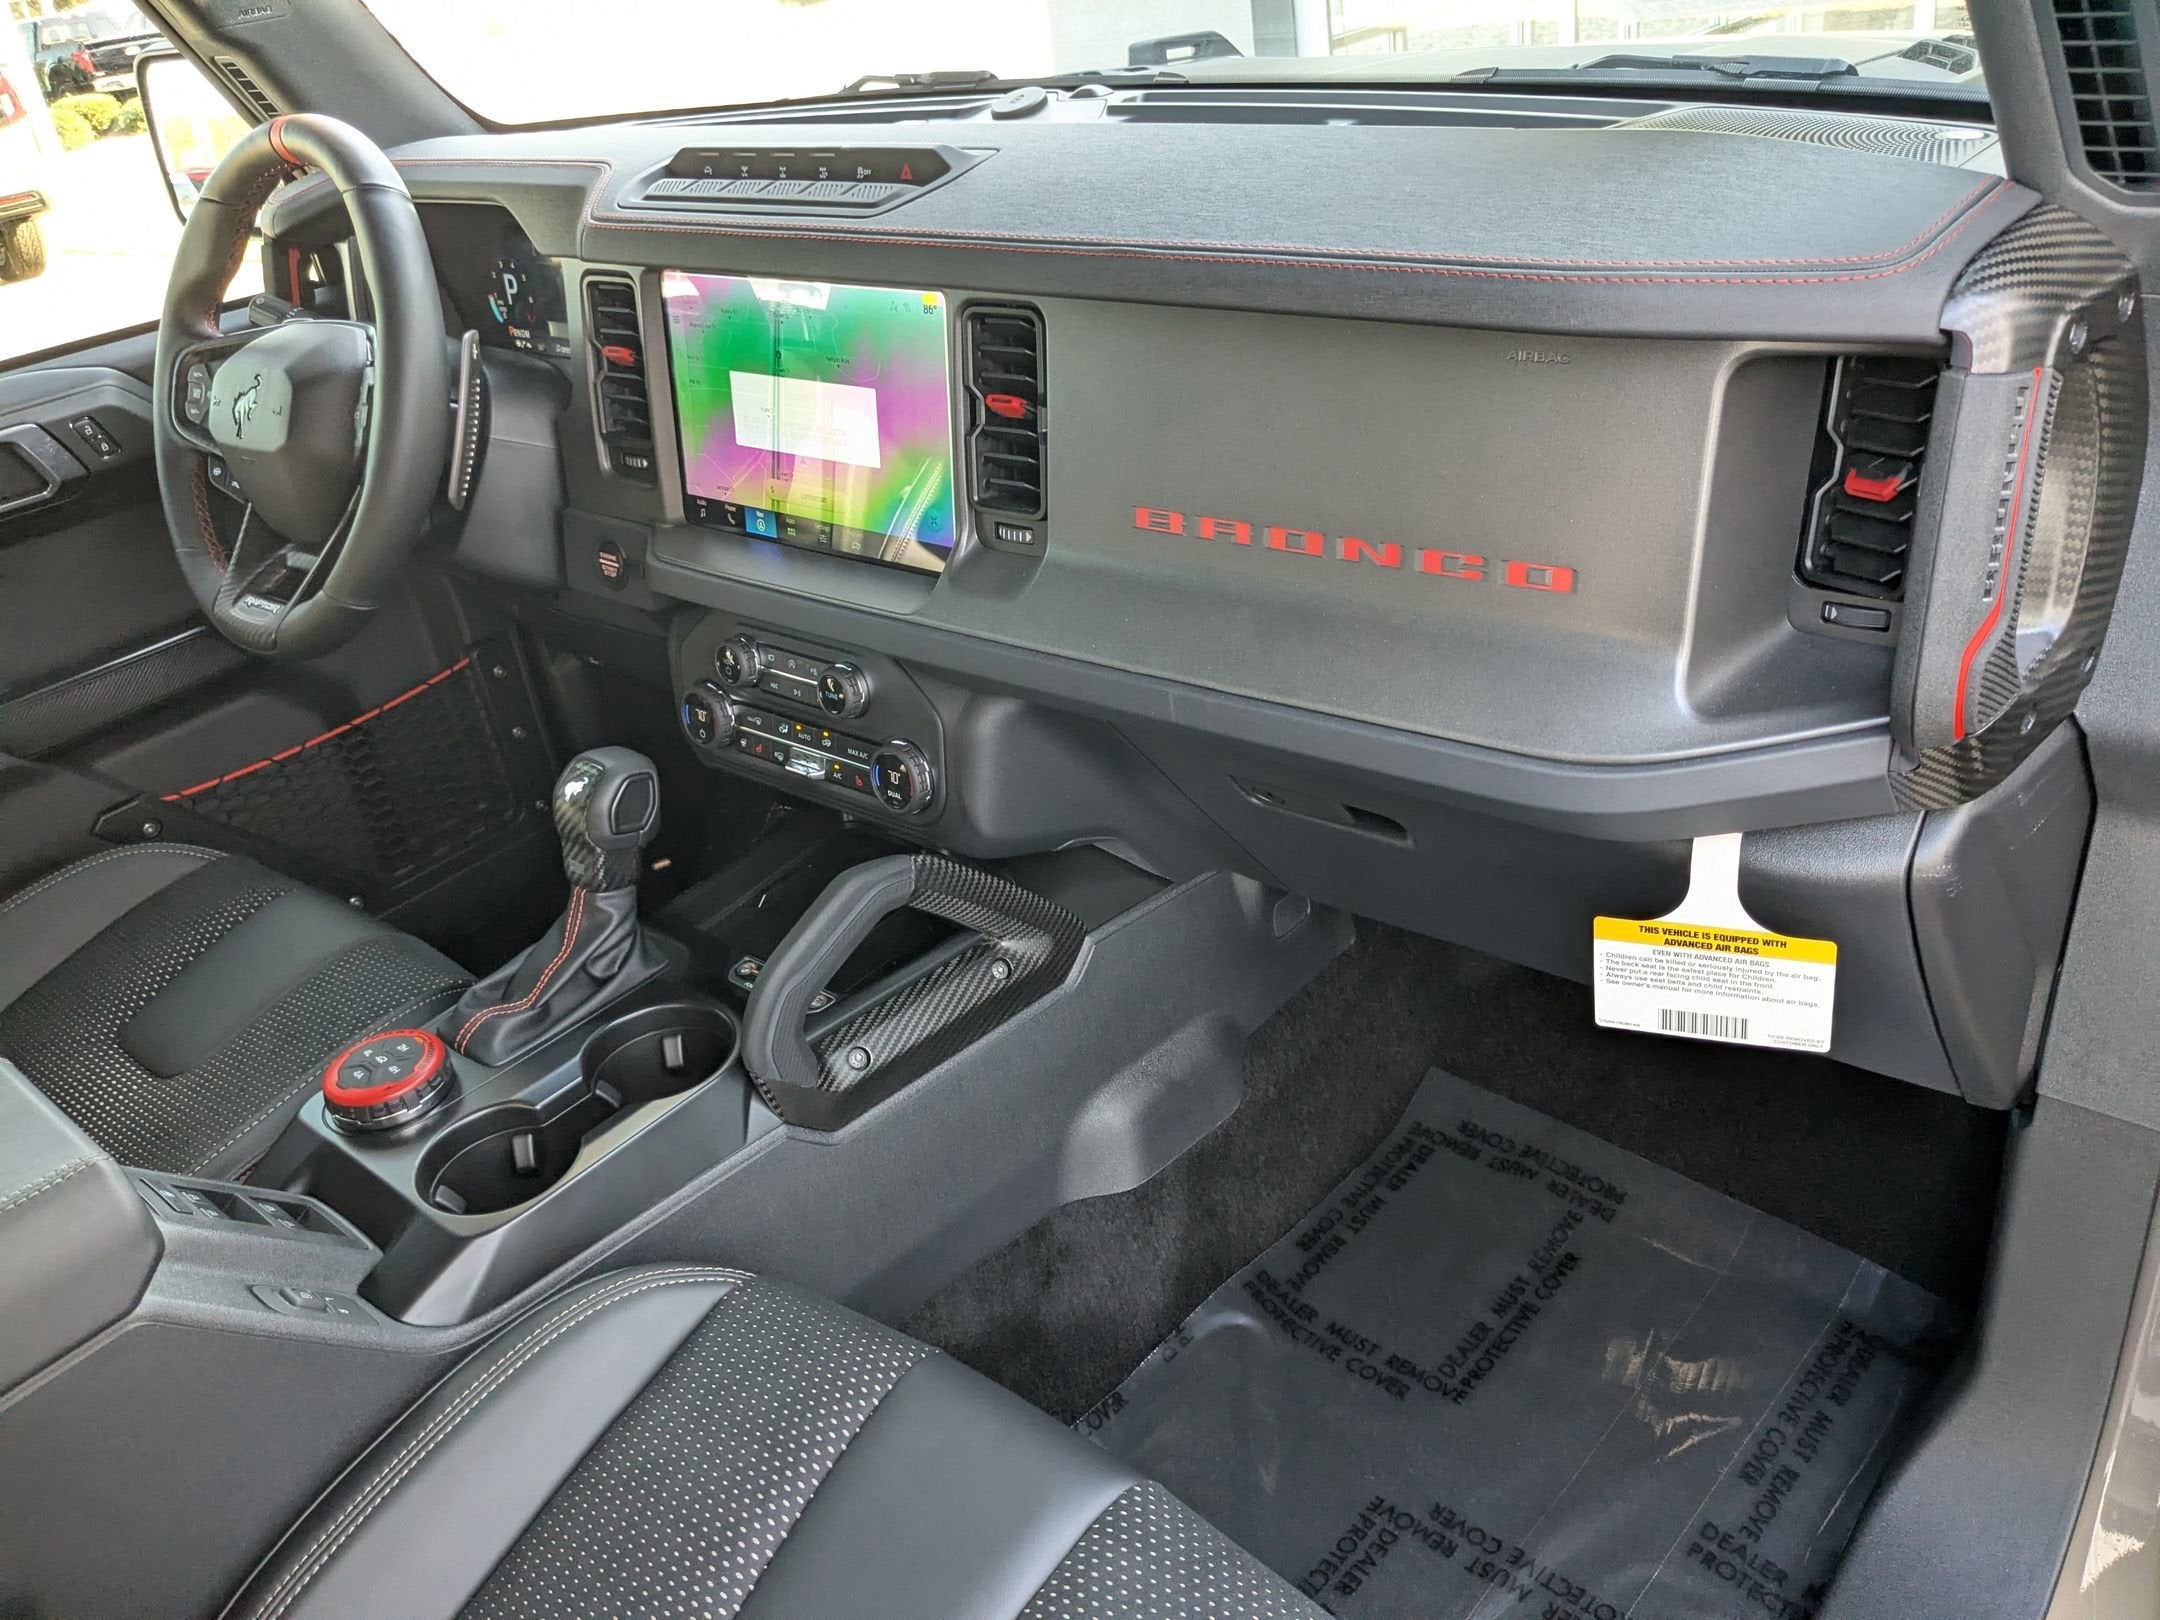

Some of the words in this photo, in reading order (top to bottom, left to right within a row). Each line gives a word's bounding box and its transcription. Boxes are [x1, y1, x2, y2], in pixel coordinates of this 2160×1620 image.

[503, 273, 518, 305] P
[1506, 350, 1571, 365] AIRBAG
[1133, 505, 1575, 593] BRONCO
[244, 596, 281, 615] RAPTOR
[825, 691, 838, 700] TUNE
[798, 733, 811, 741] AUTO
[848, 748, 859, 756] MAX
[888, 790, 902, 801] DUAL
[1638, 925, 1659, 934] THIS
[1662, 928, 1699, 938] VEHICLE
[1702, 932, 1710, 940] IS
[1714, 934, 1759, 945] EQUIPPED
[1762, 938, 1786, 948] WITH
[1664, 938, 1712, 950] ADVANCED
[1716, 944, 1731, 952] AIR
[1734, 946, 1759, 955] BAGS
[1606, 952, 1638, 960] Children
[1698, 962, 1733, 972] seriously
[1736, 966, 1762, 974] injured
[1765, 968, 1774, 976] by
[1666, 972, 1690, 980] facing
[1754, 981, 1774, 989] front.
[1694, 954, 1732, 964] ADVANCED
[1750, 960, 1770, 968] BAGS
[1706, 970, 1726, 978] place
[1742, 972, 1776, 982] Children.
[1622, 980, 1650, 988] owner's
[1652, 984, 1680, 992] manual
[1716, 990, 1760, 1000] information
[1724, 986, 1764, 994] restraints.
[1408, 1120, 1481, 1161] REMOVE
[1457, 1120, 1516, 1153] COVER
[1386, 1143, 1436, 1192] DEALER
[1486, 1156, 1539, 1180] MUST
[1518, 1144, 1628, 1204] PROTECTIVE
[1345, 1194, 1386, 1234] MUST
[1546, 1181, 1616, 1223] DEALER
[1295, 1206, 1343, 1251] COVER
[1285, 1234, 1347, 1292] REMOVE
[1438, 1321, 1495, 1379] DEALER
[1489, 1274, 1531, 1319] MUST
[1527, 1209, 1584, 1273] REMOVE
[1242, 1280, 1342, 1362] PROTECTIVE
[1345, 1358, 1411, 1402] COVER
[1257, 1270, 1320, 1323] DEALER
[1324, 1321, 1384, 1357] MUST
[1383, 1353, 1463, 1406] REMOVE
[1461, 1300, 1541, 1390] PROTECTIVE
[1534, 1251, 1582, 1300] COVER
[1738, 1427, 1788, 1487] COVER
[1792, 1409, 1834, 1464] MUST
[1738, 1463, 1801, 1544] REMOVE
[1366, 1495, 1459, 1559] REMOVE
[1428, 1501, 1502, 1556] COVER
[1332, 1527, 1399, 1596] DEALER
[1701, 1521, 1789, 1588] DEALER
[1464, 1557, 1533, 1601] MUST
